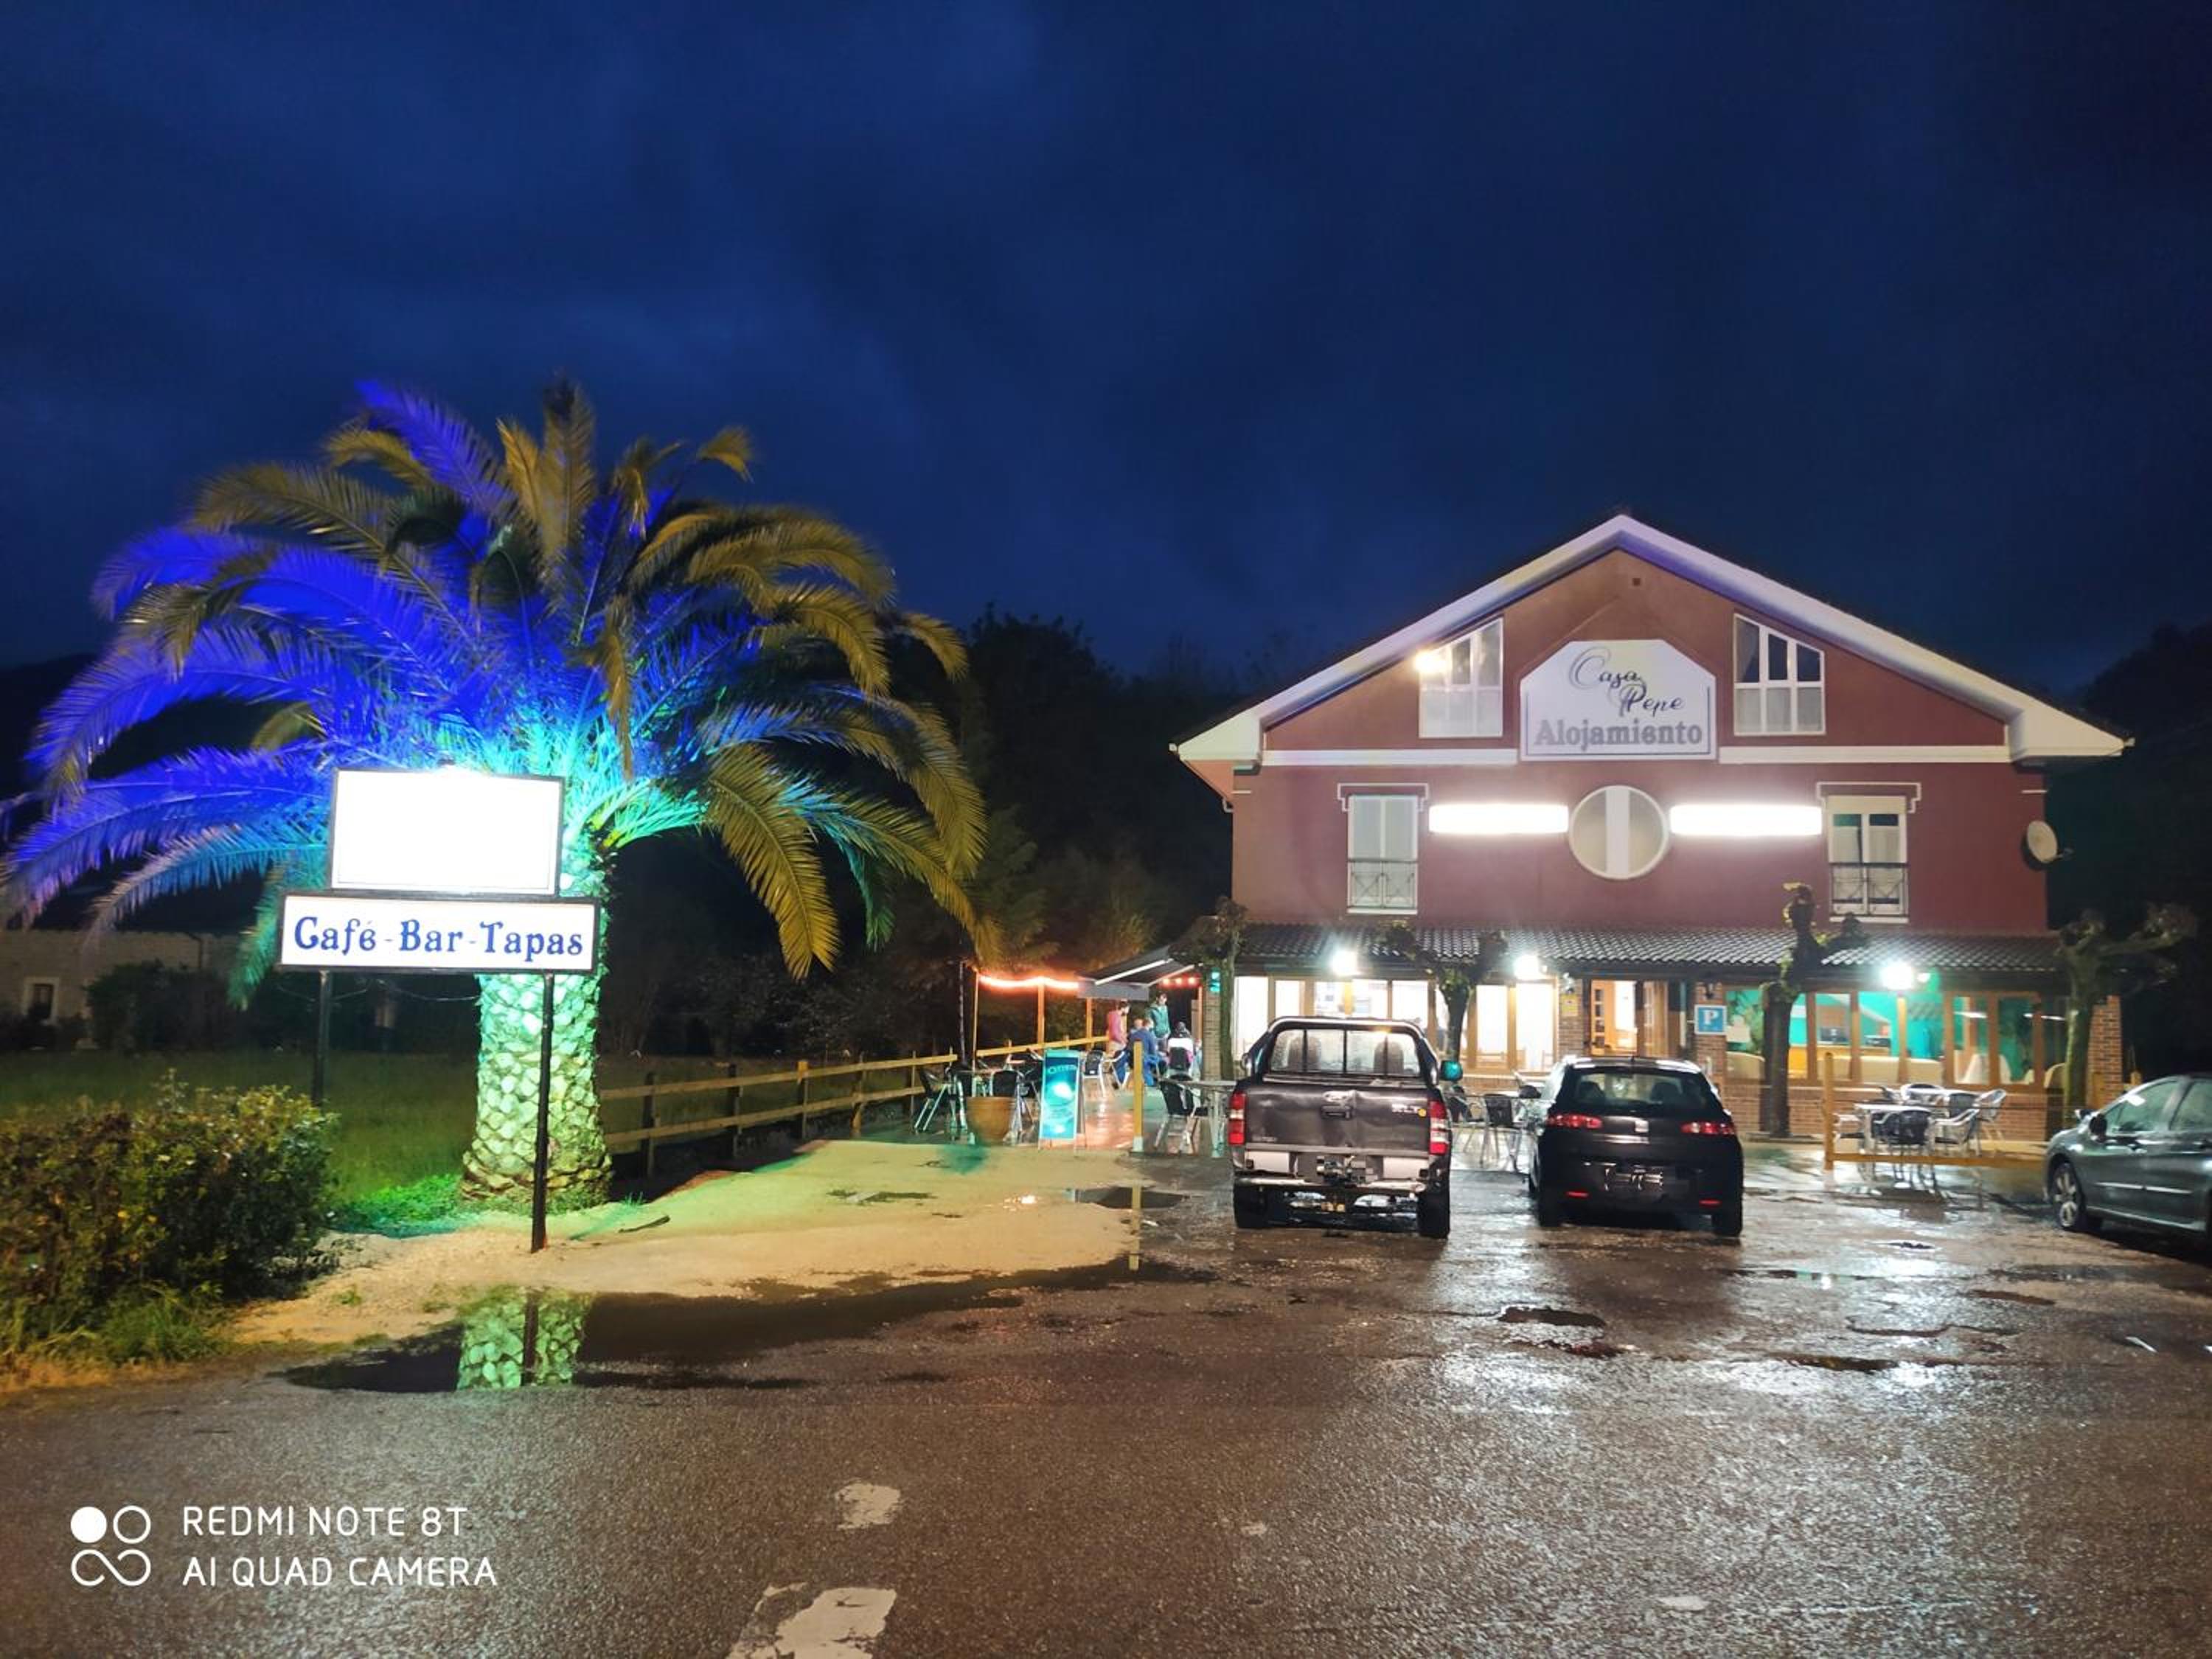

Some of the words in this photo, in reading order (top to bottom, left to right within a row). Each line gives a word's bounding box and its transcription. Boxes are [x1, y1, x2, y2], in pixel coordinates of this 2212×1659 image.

[1569, 647, 1641, 689] Casa
[1608, 683, 1684, 717] Pepe
[1534, 718, 1703, 751] Alojamiento
[1703, 1009, 1719, 1025] P
